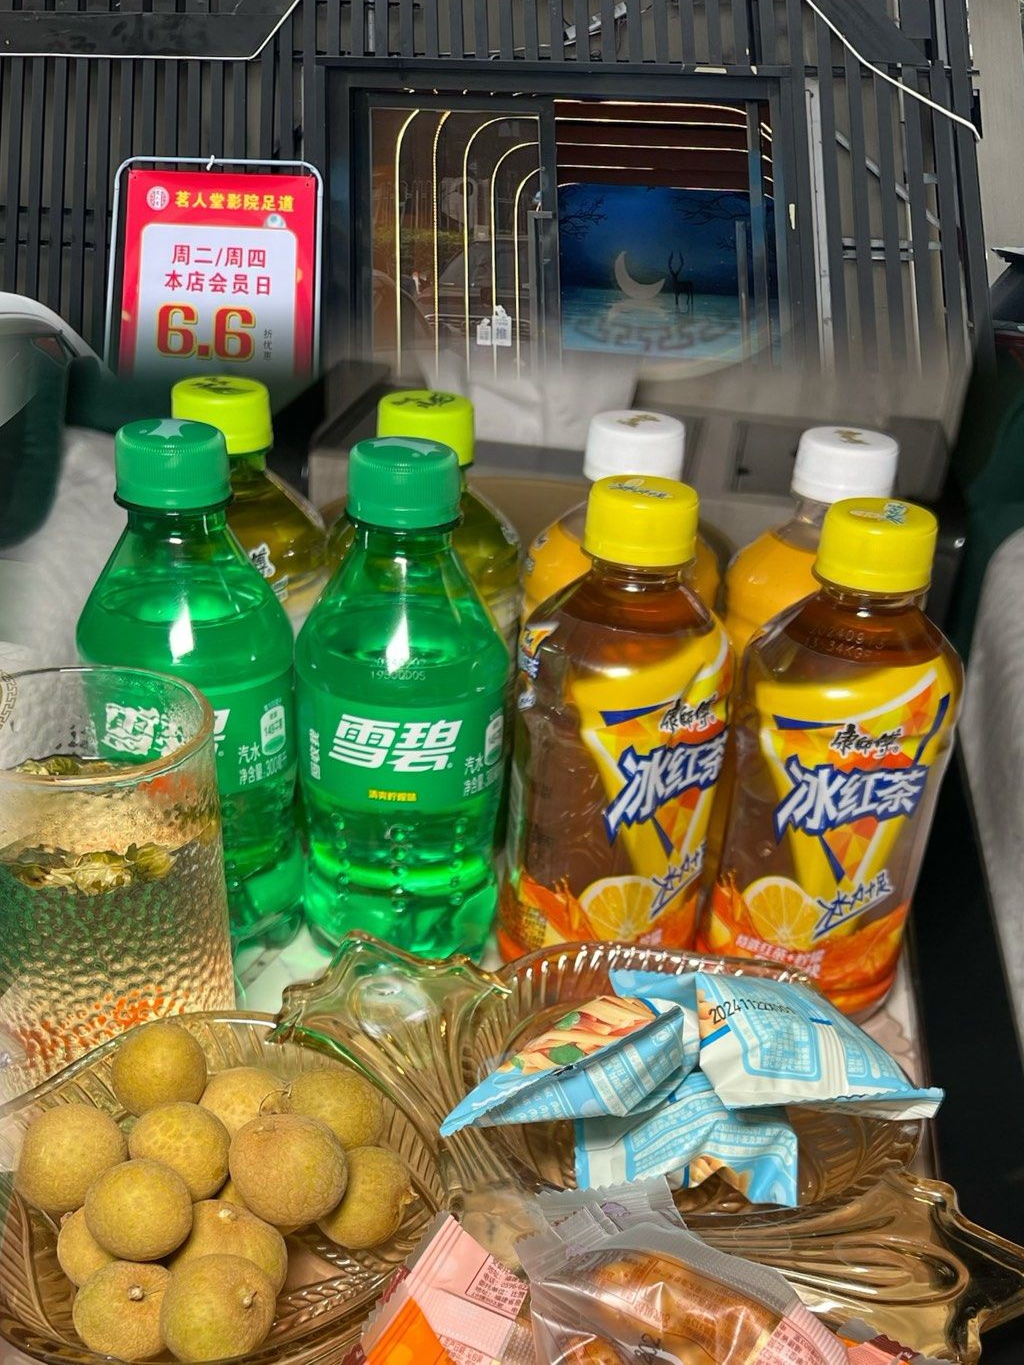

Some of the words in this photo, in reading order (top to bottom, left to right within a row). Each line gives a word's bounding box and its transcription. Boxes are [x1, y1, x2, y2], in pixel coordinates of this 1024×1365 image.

[174, 190, 295, 213] 茗人堂影院足道
[172, 244, 266, 269] 周二/周四
[164, 270, 272, 296] 本店会员日
[156, 301, 257, 362] 6.6
[238, 742, 261, 765] 汽水
[328, 713, 463, 773] 雪碧
[831, 723, 901, 757] 康师傅
[464, 752, 484, 776] 汽水
[776, 754, 925, 833] 冰红茶
[651, 850, 704, 918] 冰力十
